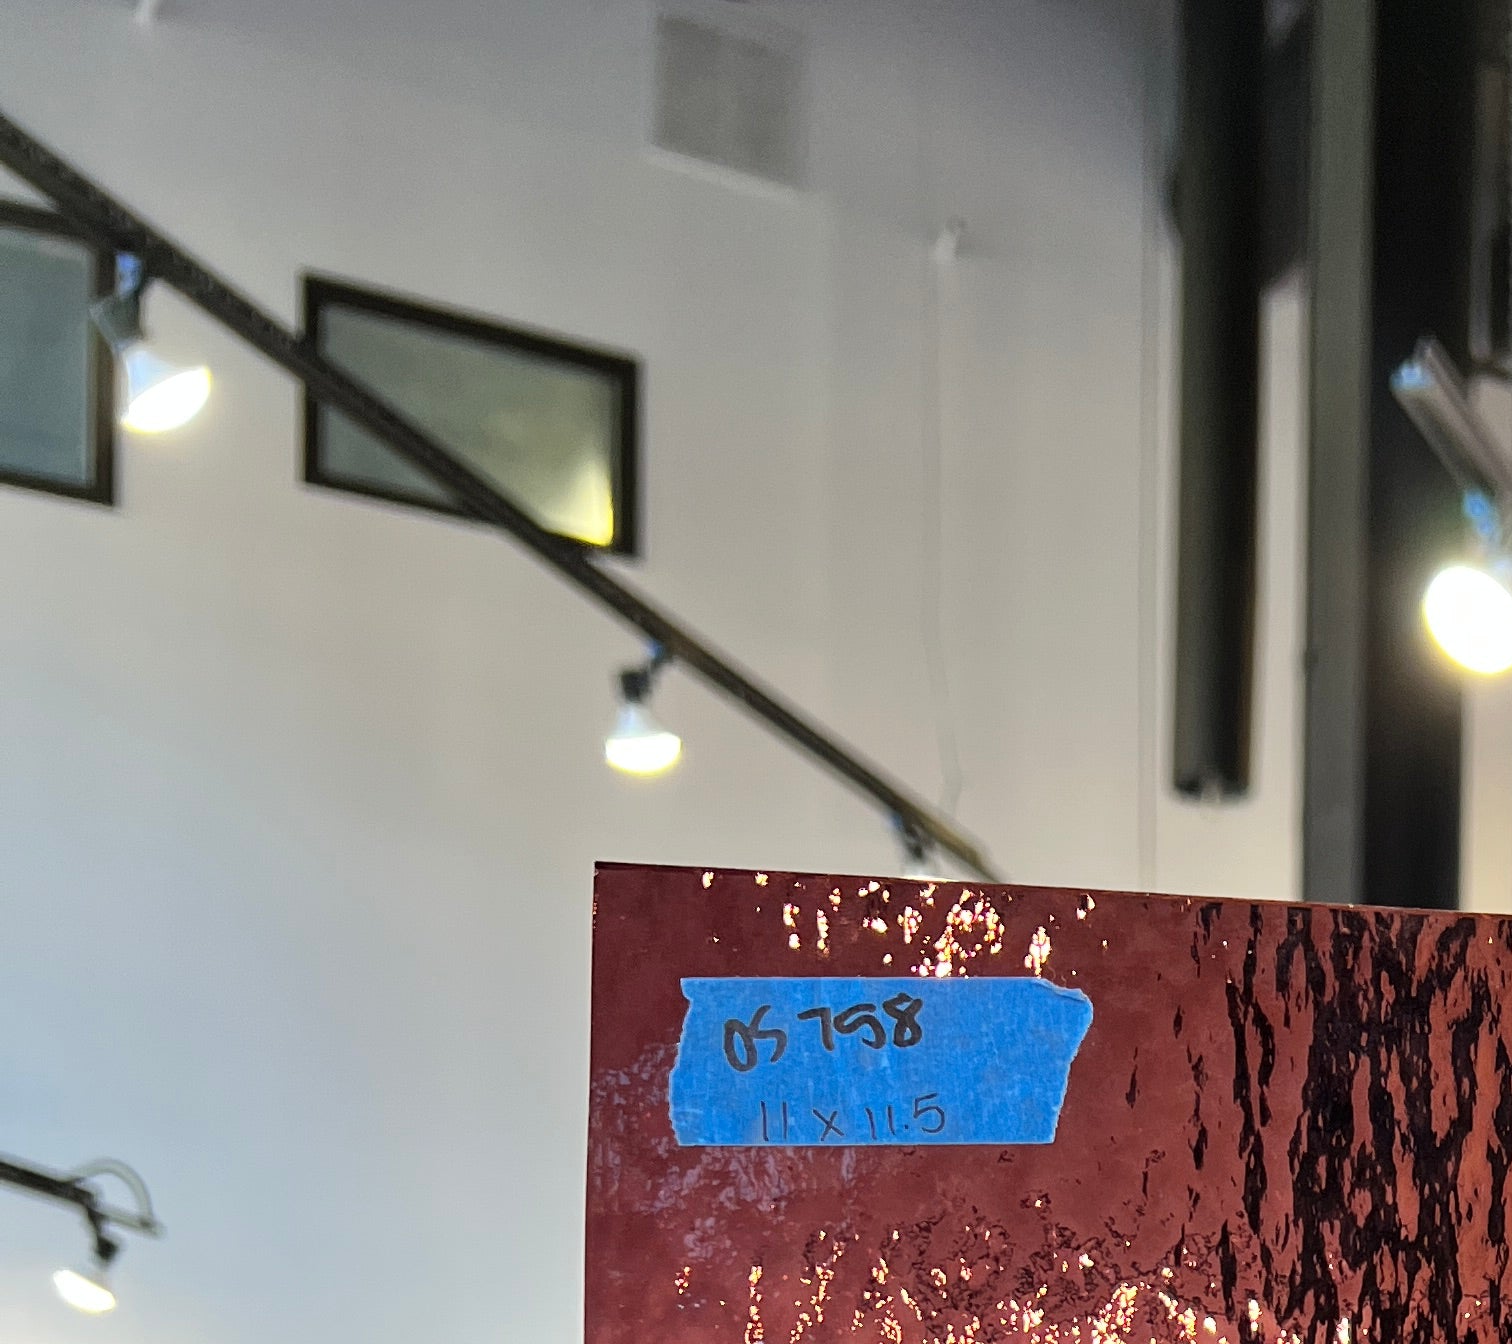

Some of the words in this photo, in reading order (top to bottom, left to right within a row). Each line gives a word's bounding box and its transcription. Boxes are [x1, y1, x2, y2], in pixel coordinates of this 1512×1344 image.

[797, 992, 923, 1051] 758
[760, 1100, 789, 1142] 11
[865, 1092, 946, 1141] 11.5
